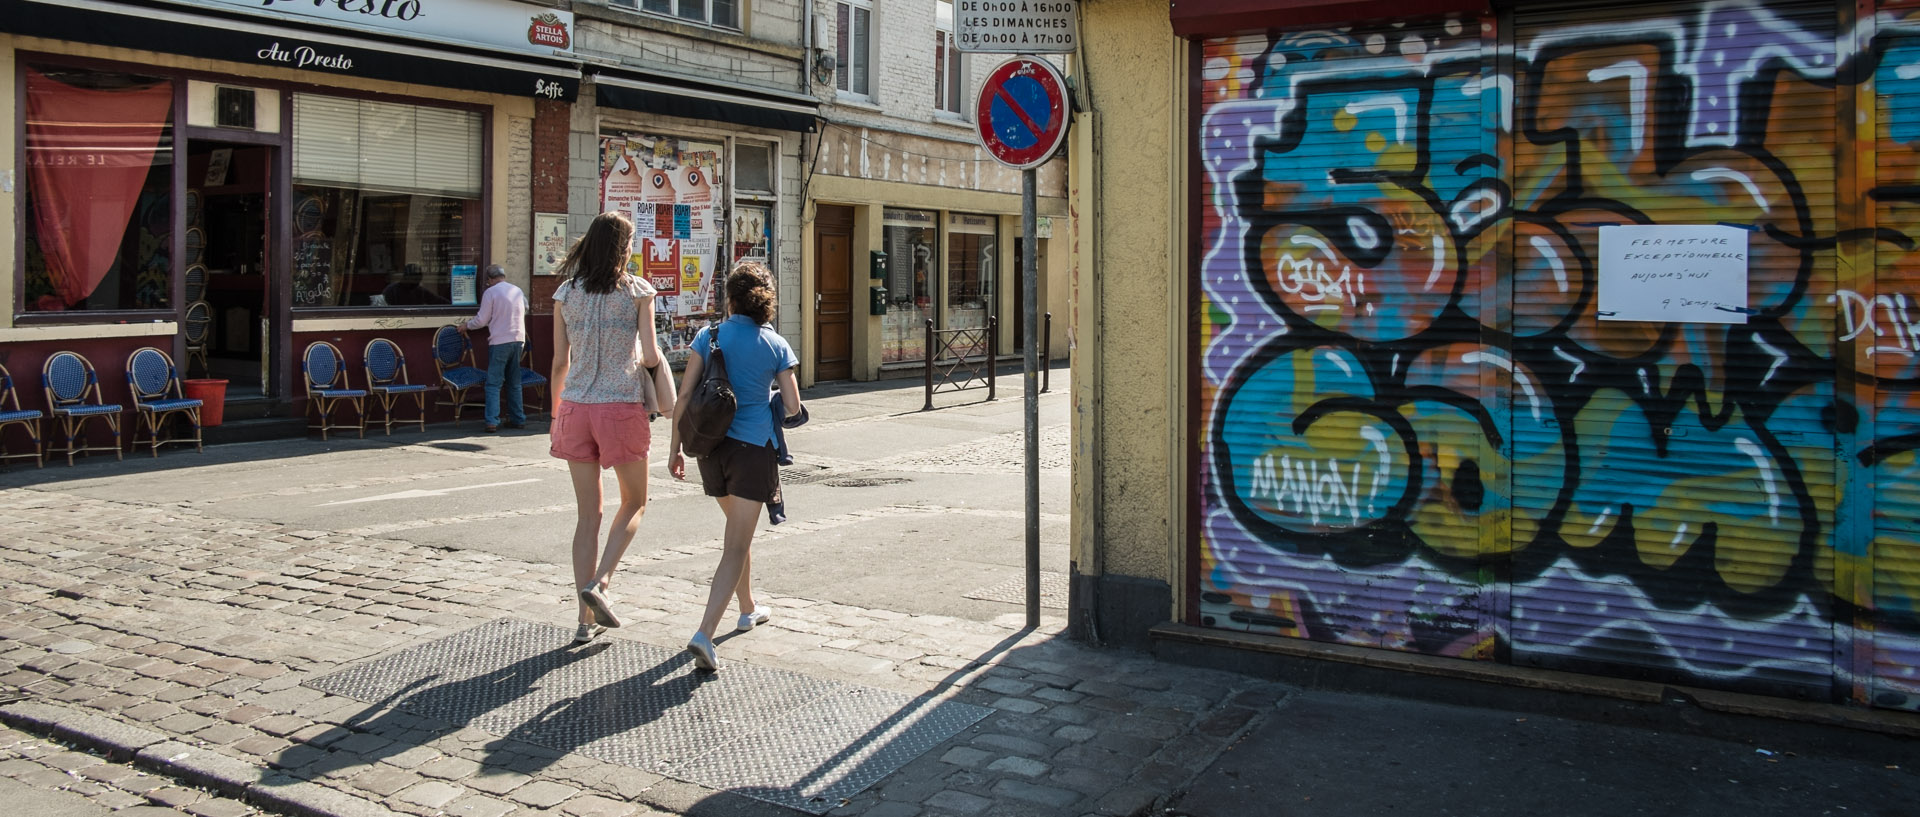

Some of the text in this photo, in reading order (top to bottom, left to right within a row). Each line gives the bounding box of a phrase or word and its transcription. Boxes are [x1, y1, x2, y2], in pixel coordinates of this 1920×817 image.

[962, 1, 1072, 13] DE 0h00 À 16h00
[965, 17, 1067, 28] LES DIMANCHES
[535, 25, 563, 36] STELLA
[535, 33, 563, 44] ARTOIS
[962, 32, 1072, 44] DE 0h00 À 17h00
[257, 42, 354, 70] Au Presto
[535, 78, 564, 99] Leffe
[637, 202, 655, 214] ROAR!
[1632, 238, 1728, 246] FERMETURE
[1624, 250, 1744, 261] EXCEPTIONNELLE
[1631, 269, 1712, 282] AUJOURD'HUI
